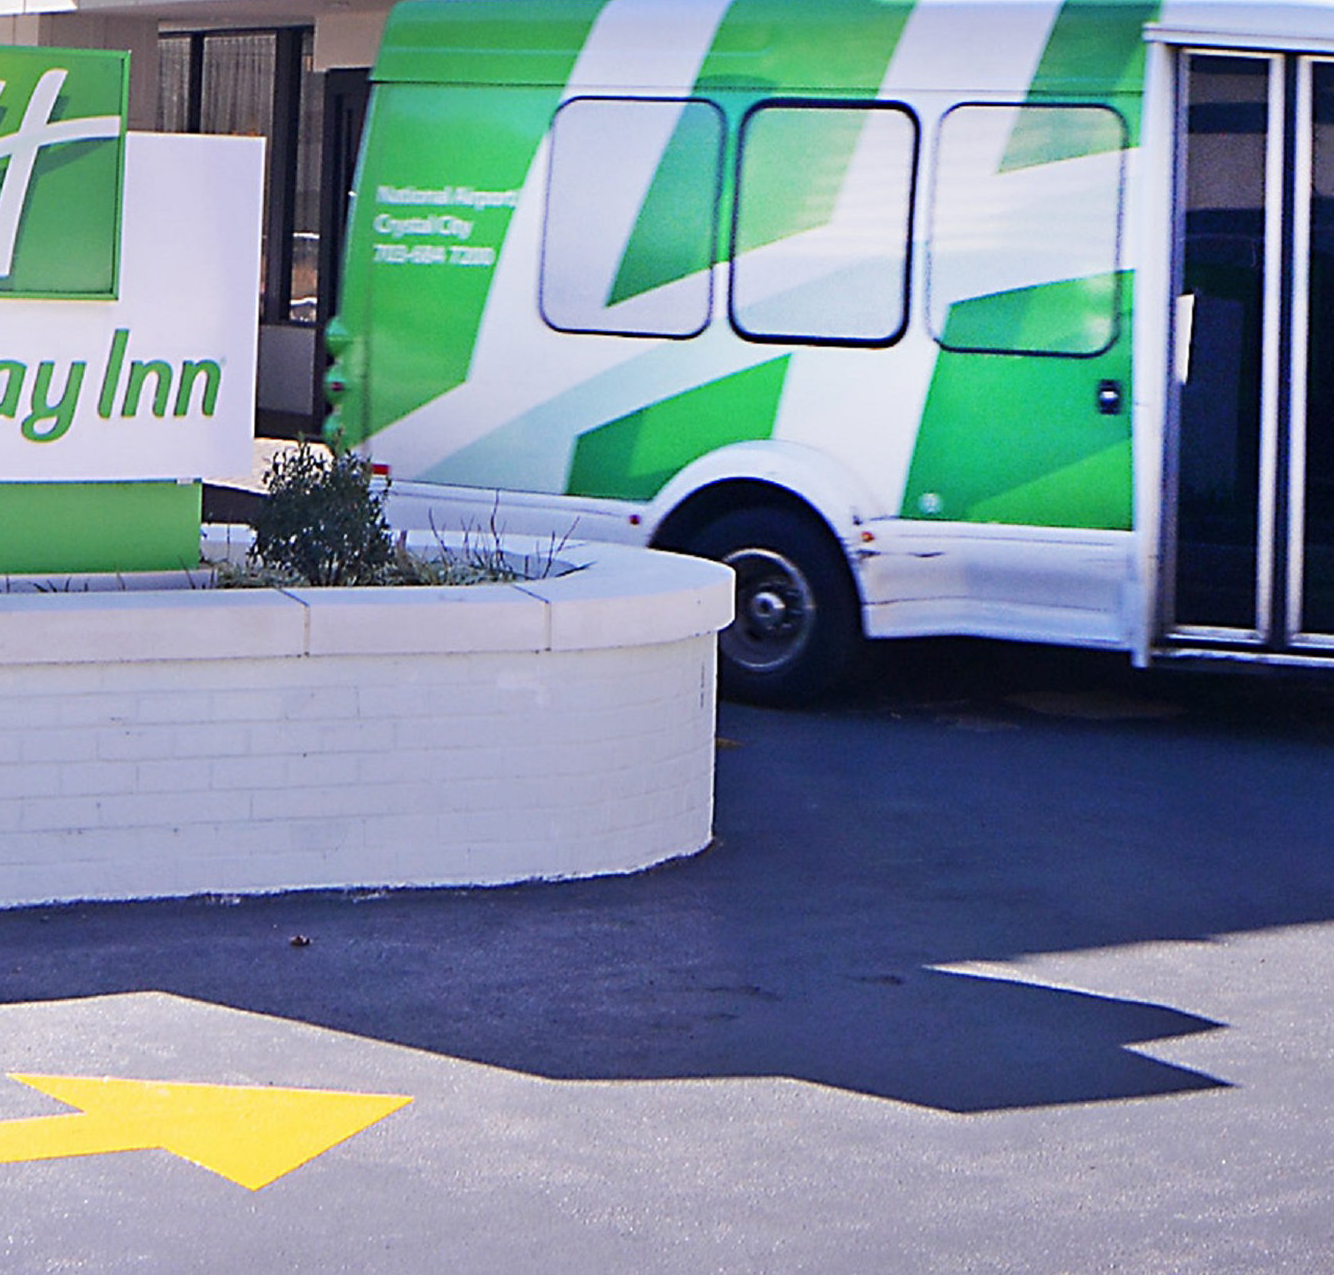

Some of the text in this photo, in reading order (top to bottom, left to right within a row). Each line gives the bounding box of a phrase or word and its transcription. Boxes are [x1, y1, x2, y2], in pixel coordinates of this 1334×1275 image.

[375, 185, 518, 211] National Airport
[373, 213, 474, 240] Crystal City
[98, 329, 222, 419] Inn
